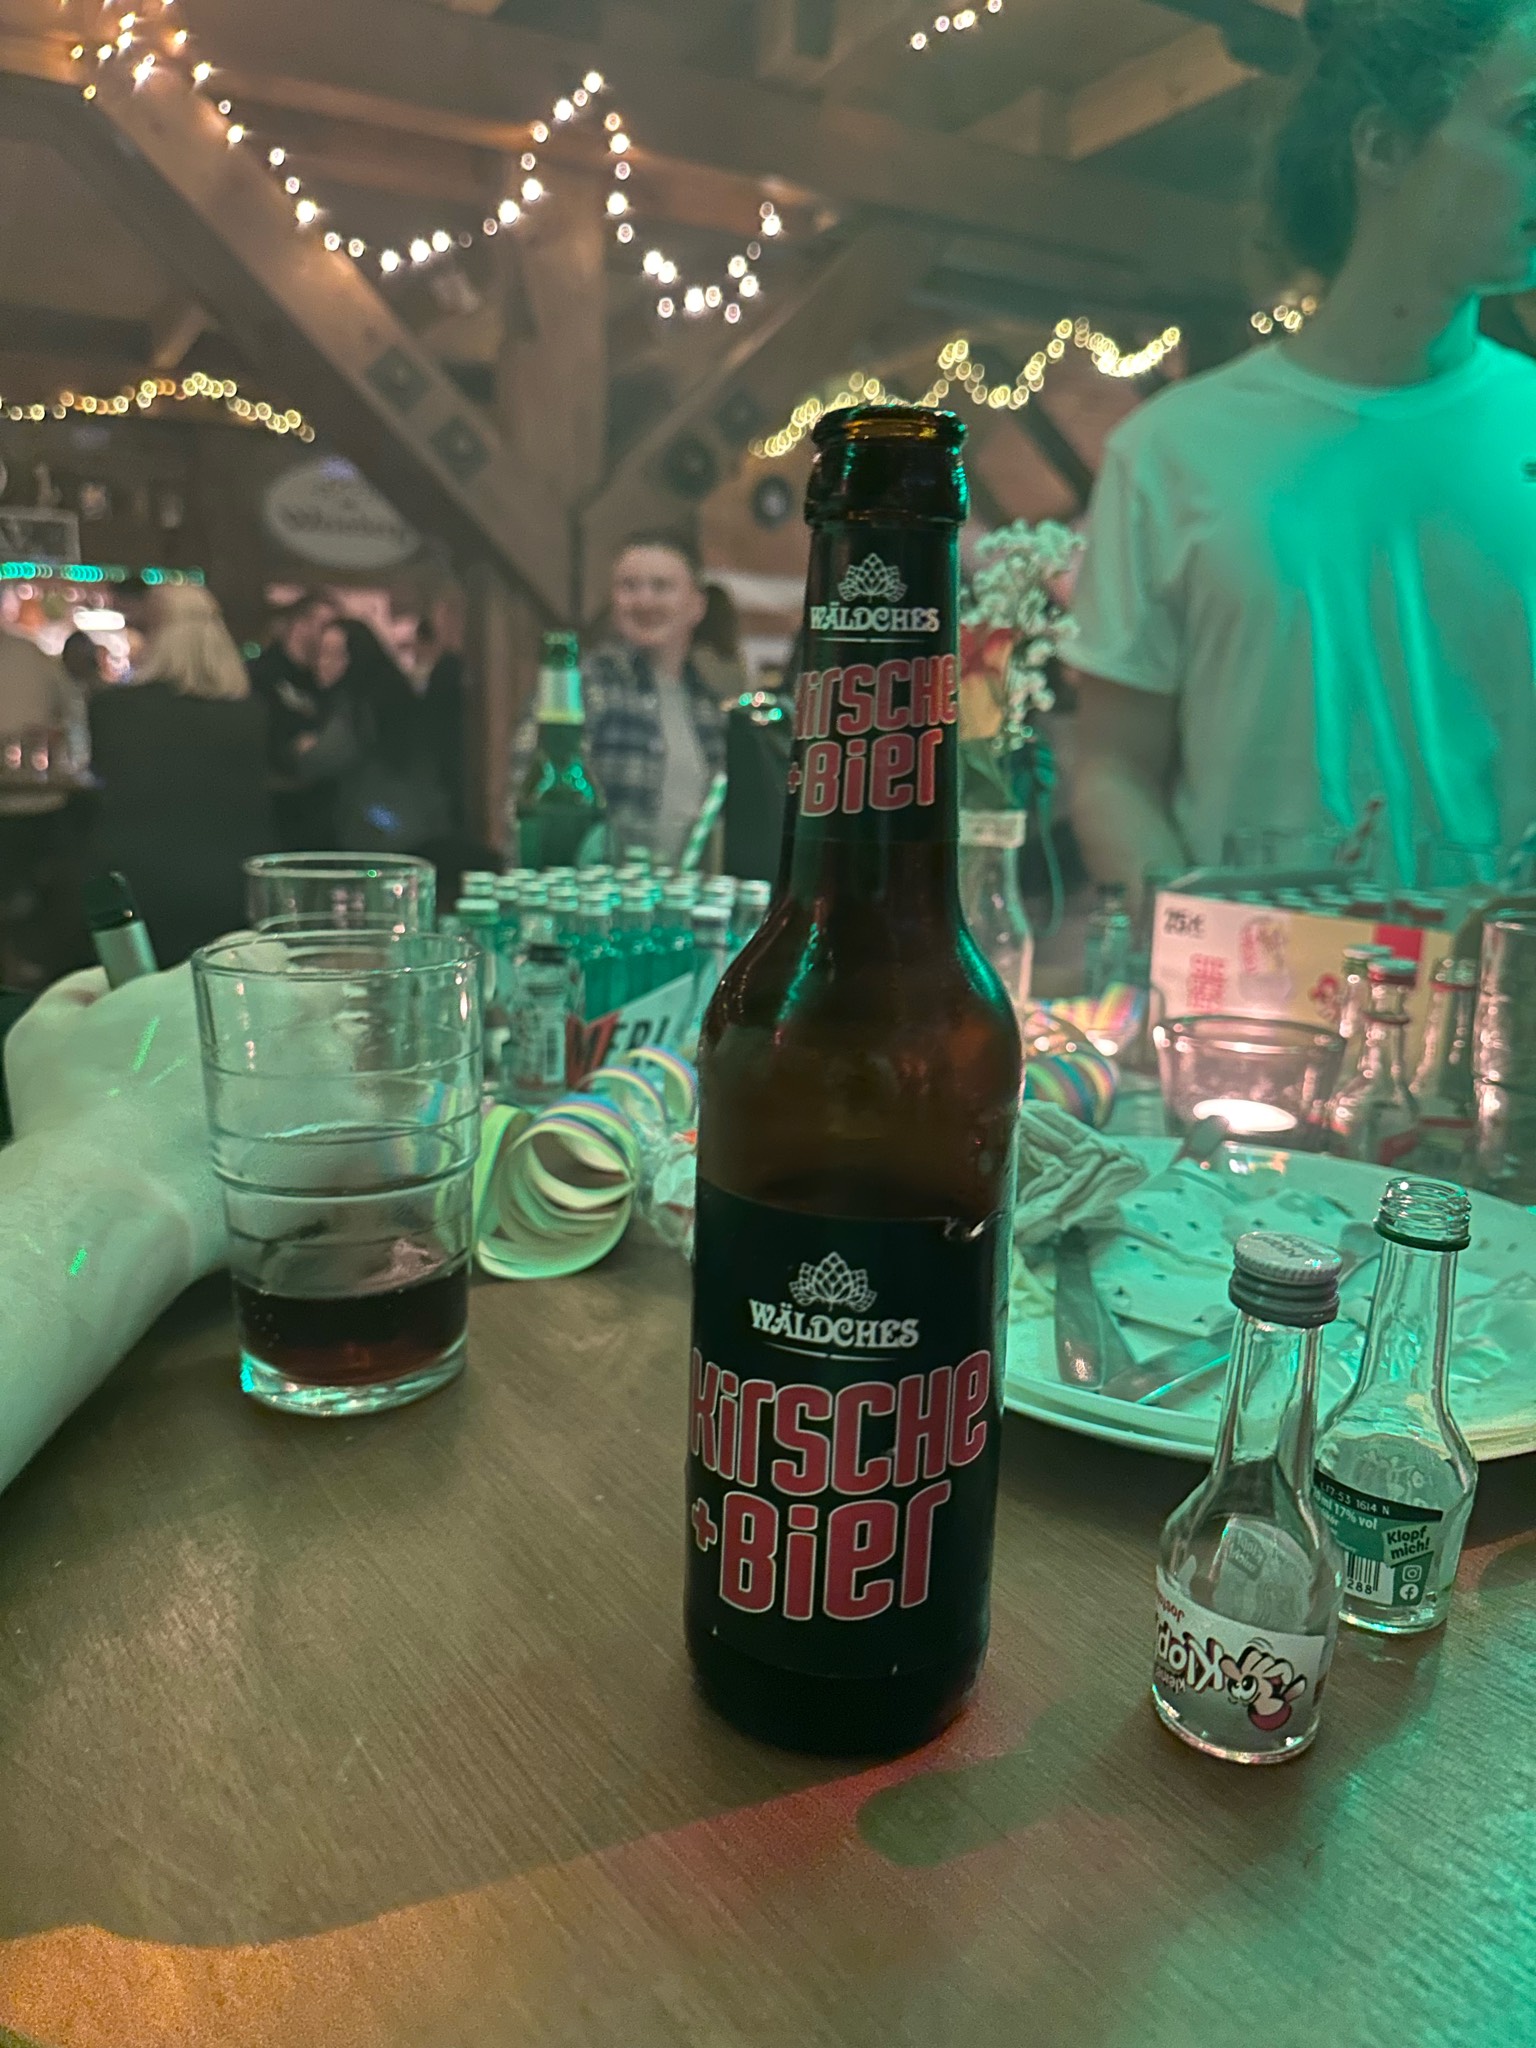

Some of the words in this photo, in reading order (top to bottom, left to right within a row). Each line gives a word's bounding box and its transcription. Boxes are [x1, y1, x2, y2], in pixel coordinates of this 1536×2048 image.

[810, 602, 940, 632] WÄLDCHES
[749, 1299, 920, 1349] WÄLDCHES
[1334, 1503, 1357, 1524] 17%
[1358, 1516, 1378, 1530] vol
[1382, 1505, 1390, 1516] N
[1387, 1525, 1428, 1545] Klopf
[1391, 1536, 1431, 1560] mich!
[1346, 1578, 1373, 1595] 288
[1156, 1621, 1225, 1694] Klop
